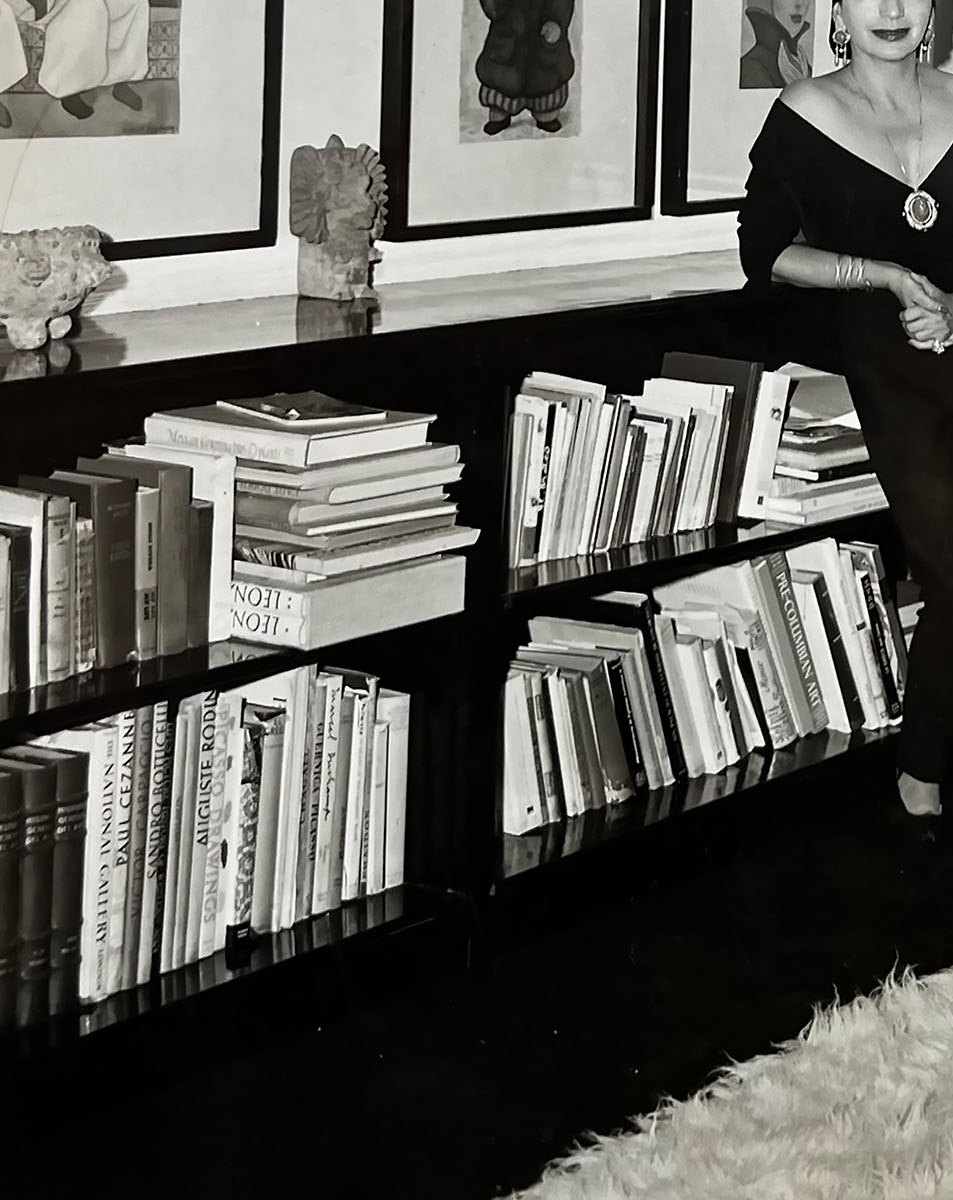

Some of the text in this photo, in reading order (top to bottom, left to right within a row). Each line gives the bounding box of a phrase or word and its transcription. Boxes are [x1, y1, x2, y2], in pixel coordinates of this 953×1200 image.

[231, 609, 280, 635] LEON
[776, 571, 822, 708] PRE-COLUMBIAN ART
[100, 763, 115, 856] NATIONAL
[115, 710, 136, 867] PAUL CEZANNE
[197, 690, 218, 846] AUGUSTE RODIN
[203, 703, 232, 924] PICASSO DRAWINGS
[311, 722, 323, 793] GUERNICA
[131, 719, 151, 918] VICTOR CARPACCIO
[147, 806, 163, 880] SANDRO
[96, 864, 110, 945] GALLERY
